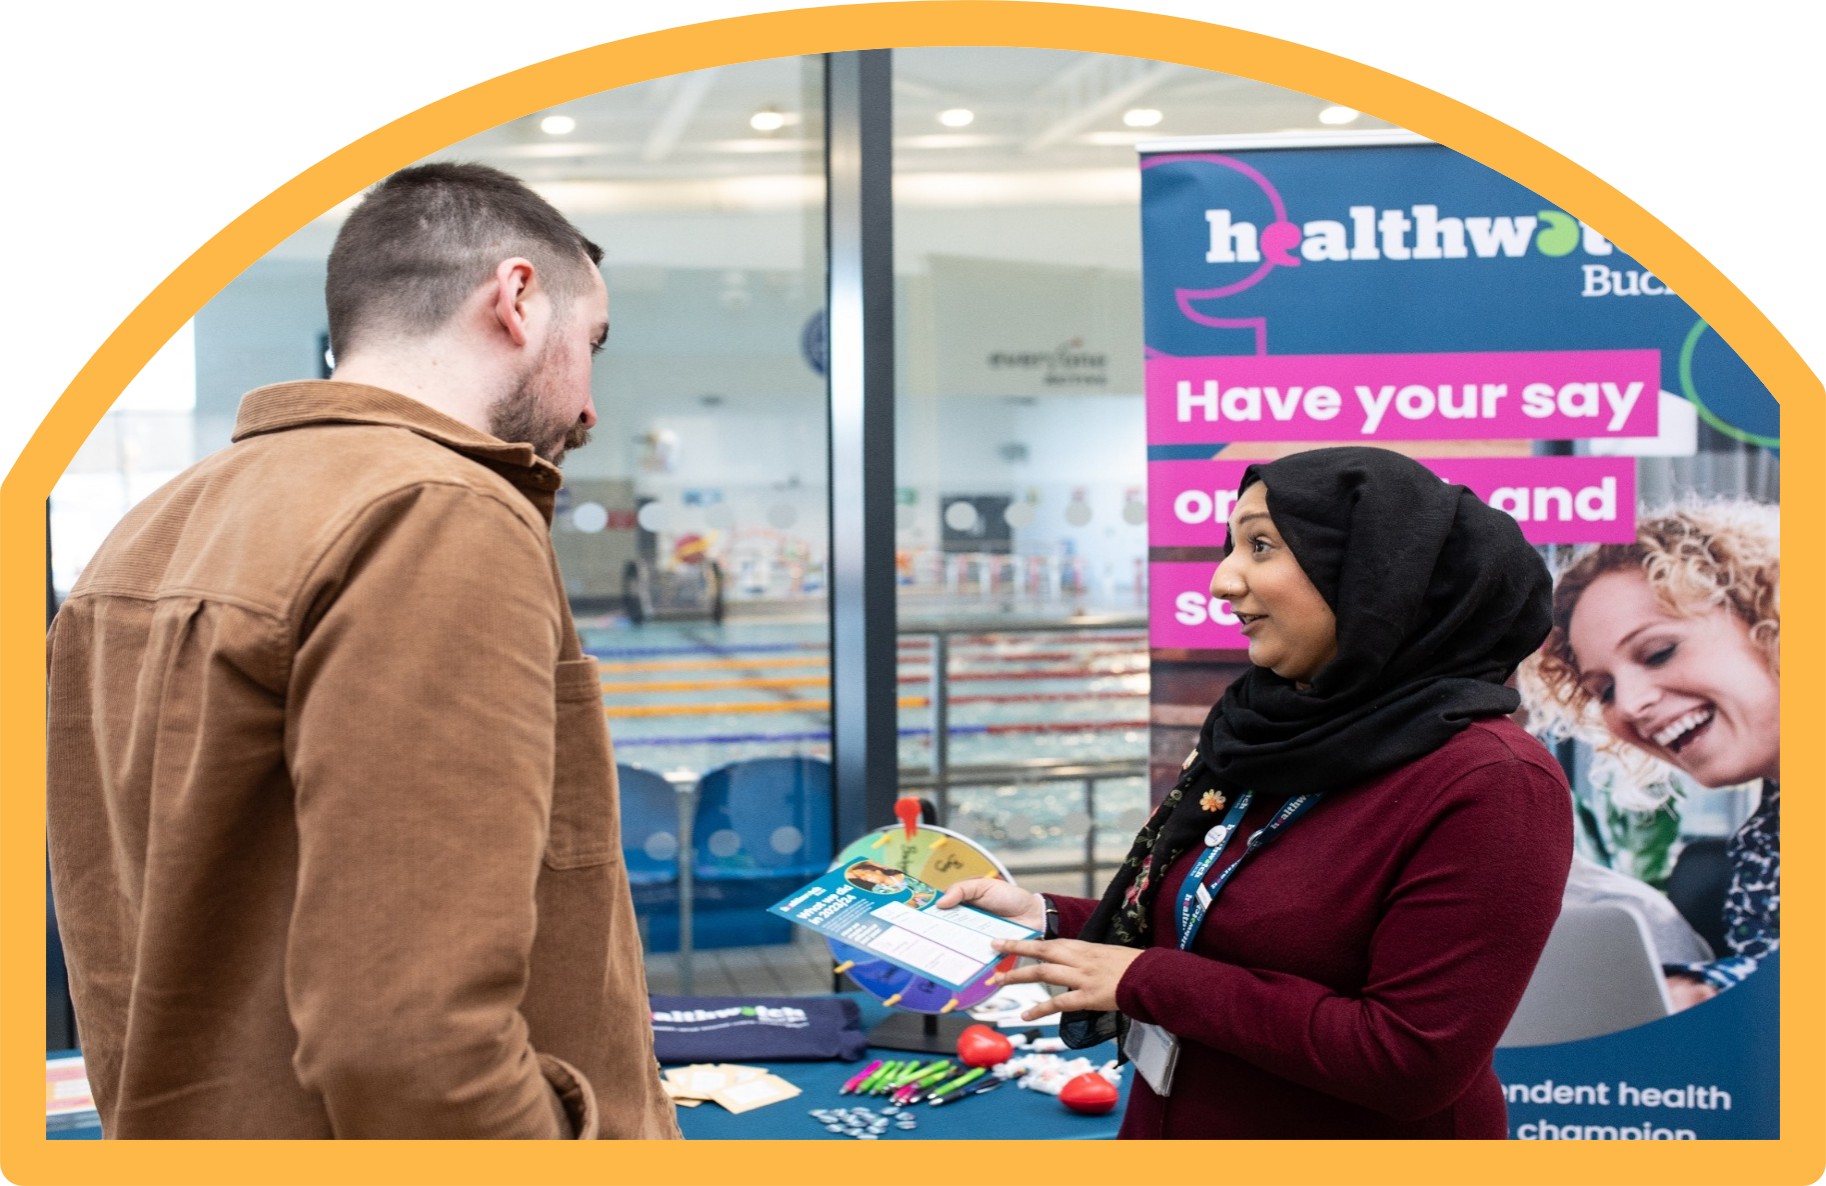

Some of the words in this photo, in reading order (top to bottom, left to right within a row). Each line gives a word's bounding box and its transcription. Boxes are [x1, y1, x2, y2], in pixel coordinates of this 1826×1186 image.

[1205, 205, 1628, 267] healthwat
[1580, 263, 1678, 298] Buc
[1175, 379, 1342, 423] Have
[1355, 383, 1507, 434] your
[1521, 380, 1645, 431] say
[1488, 475, 1618, 523] and
[796, 901, 826, 919] What
[821, 893, 840, 904] we
[835, 884, 854, 895] did
[807, 916, 824, 926] in
[1618, 1081, 1732, 1111] health
[1517, 1119, 1697, 1140] champion
